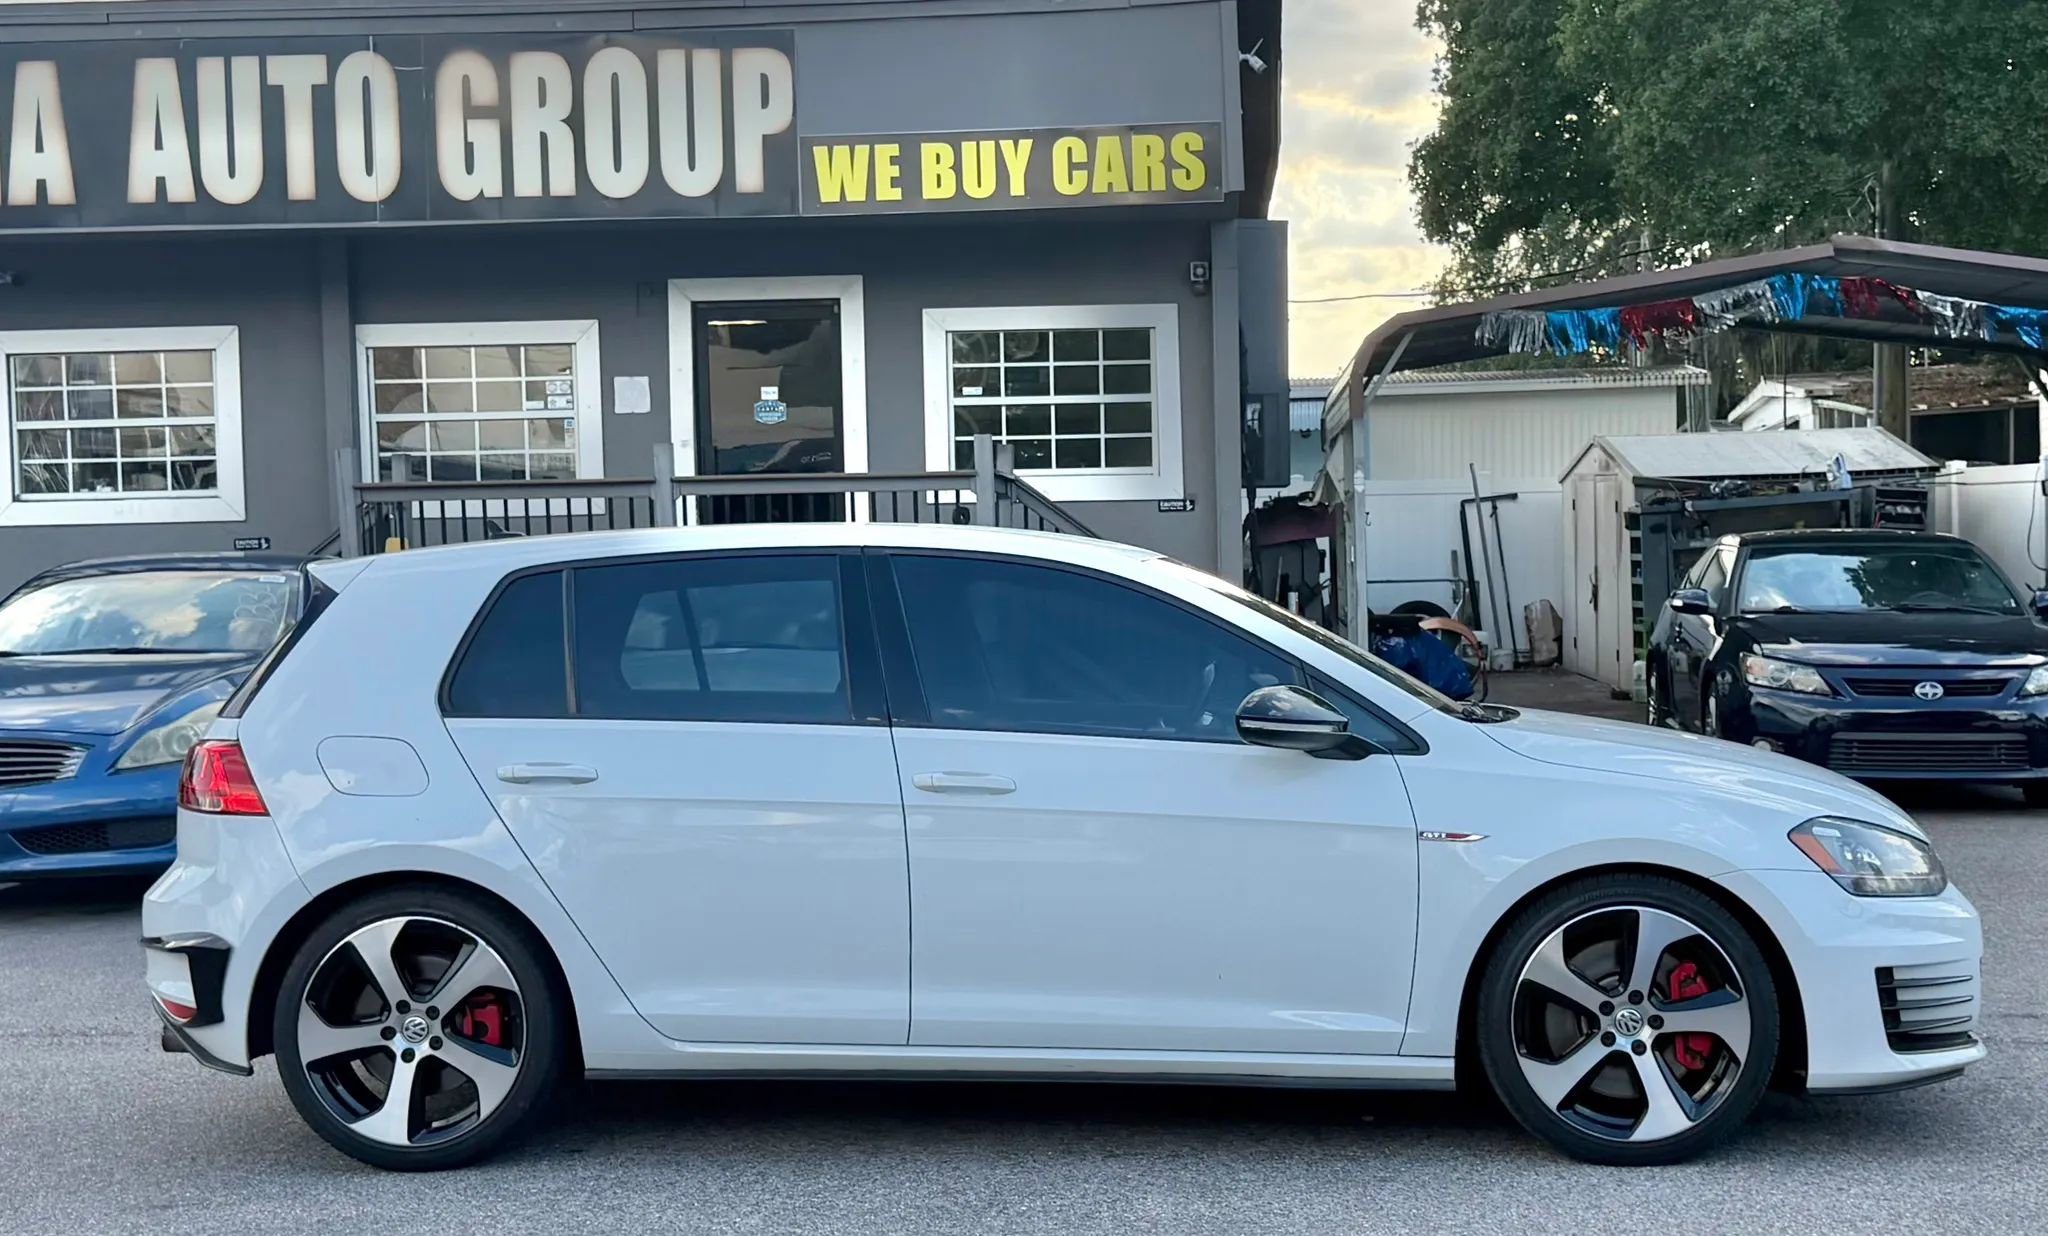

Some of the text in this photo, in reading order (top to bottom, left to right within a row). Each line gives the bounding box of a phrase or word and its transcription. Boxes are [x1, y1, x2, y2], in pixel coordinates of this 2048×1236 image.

[0, 46, 795, 206] A AUTO GROUP
[812, 131, 1207, 204] WE BUY CARS
